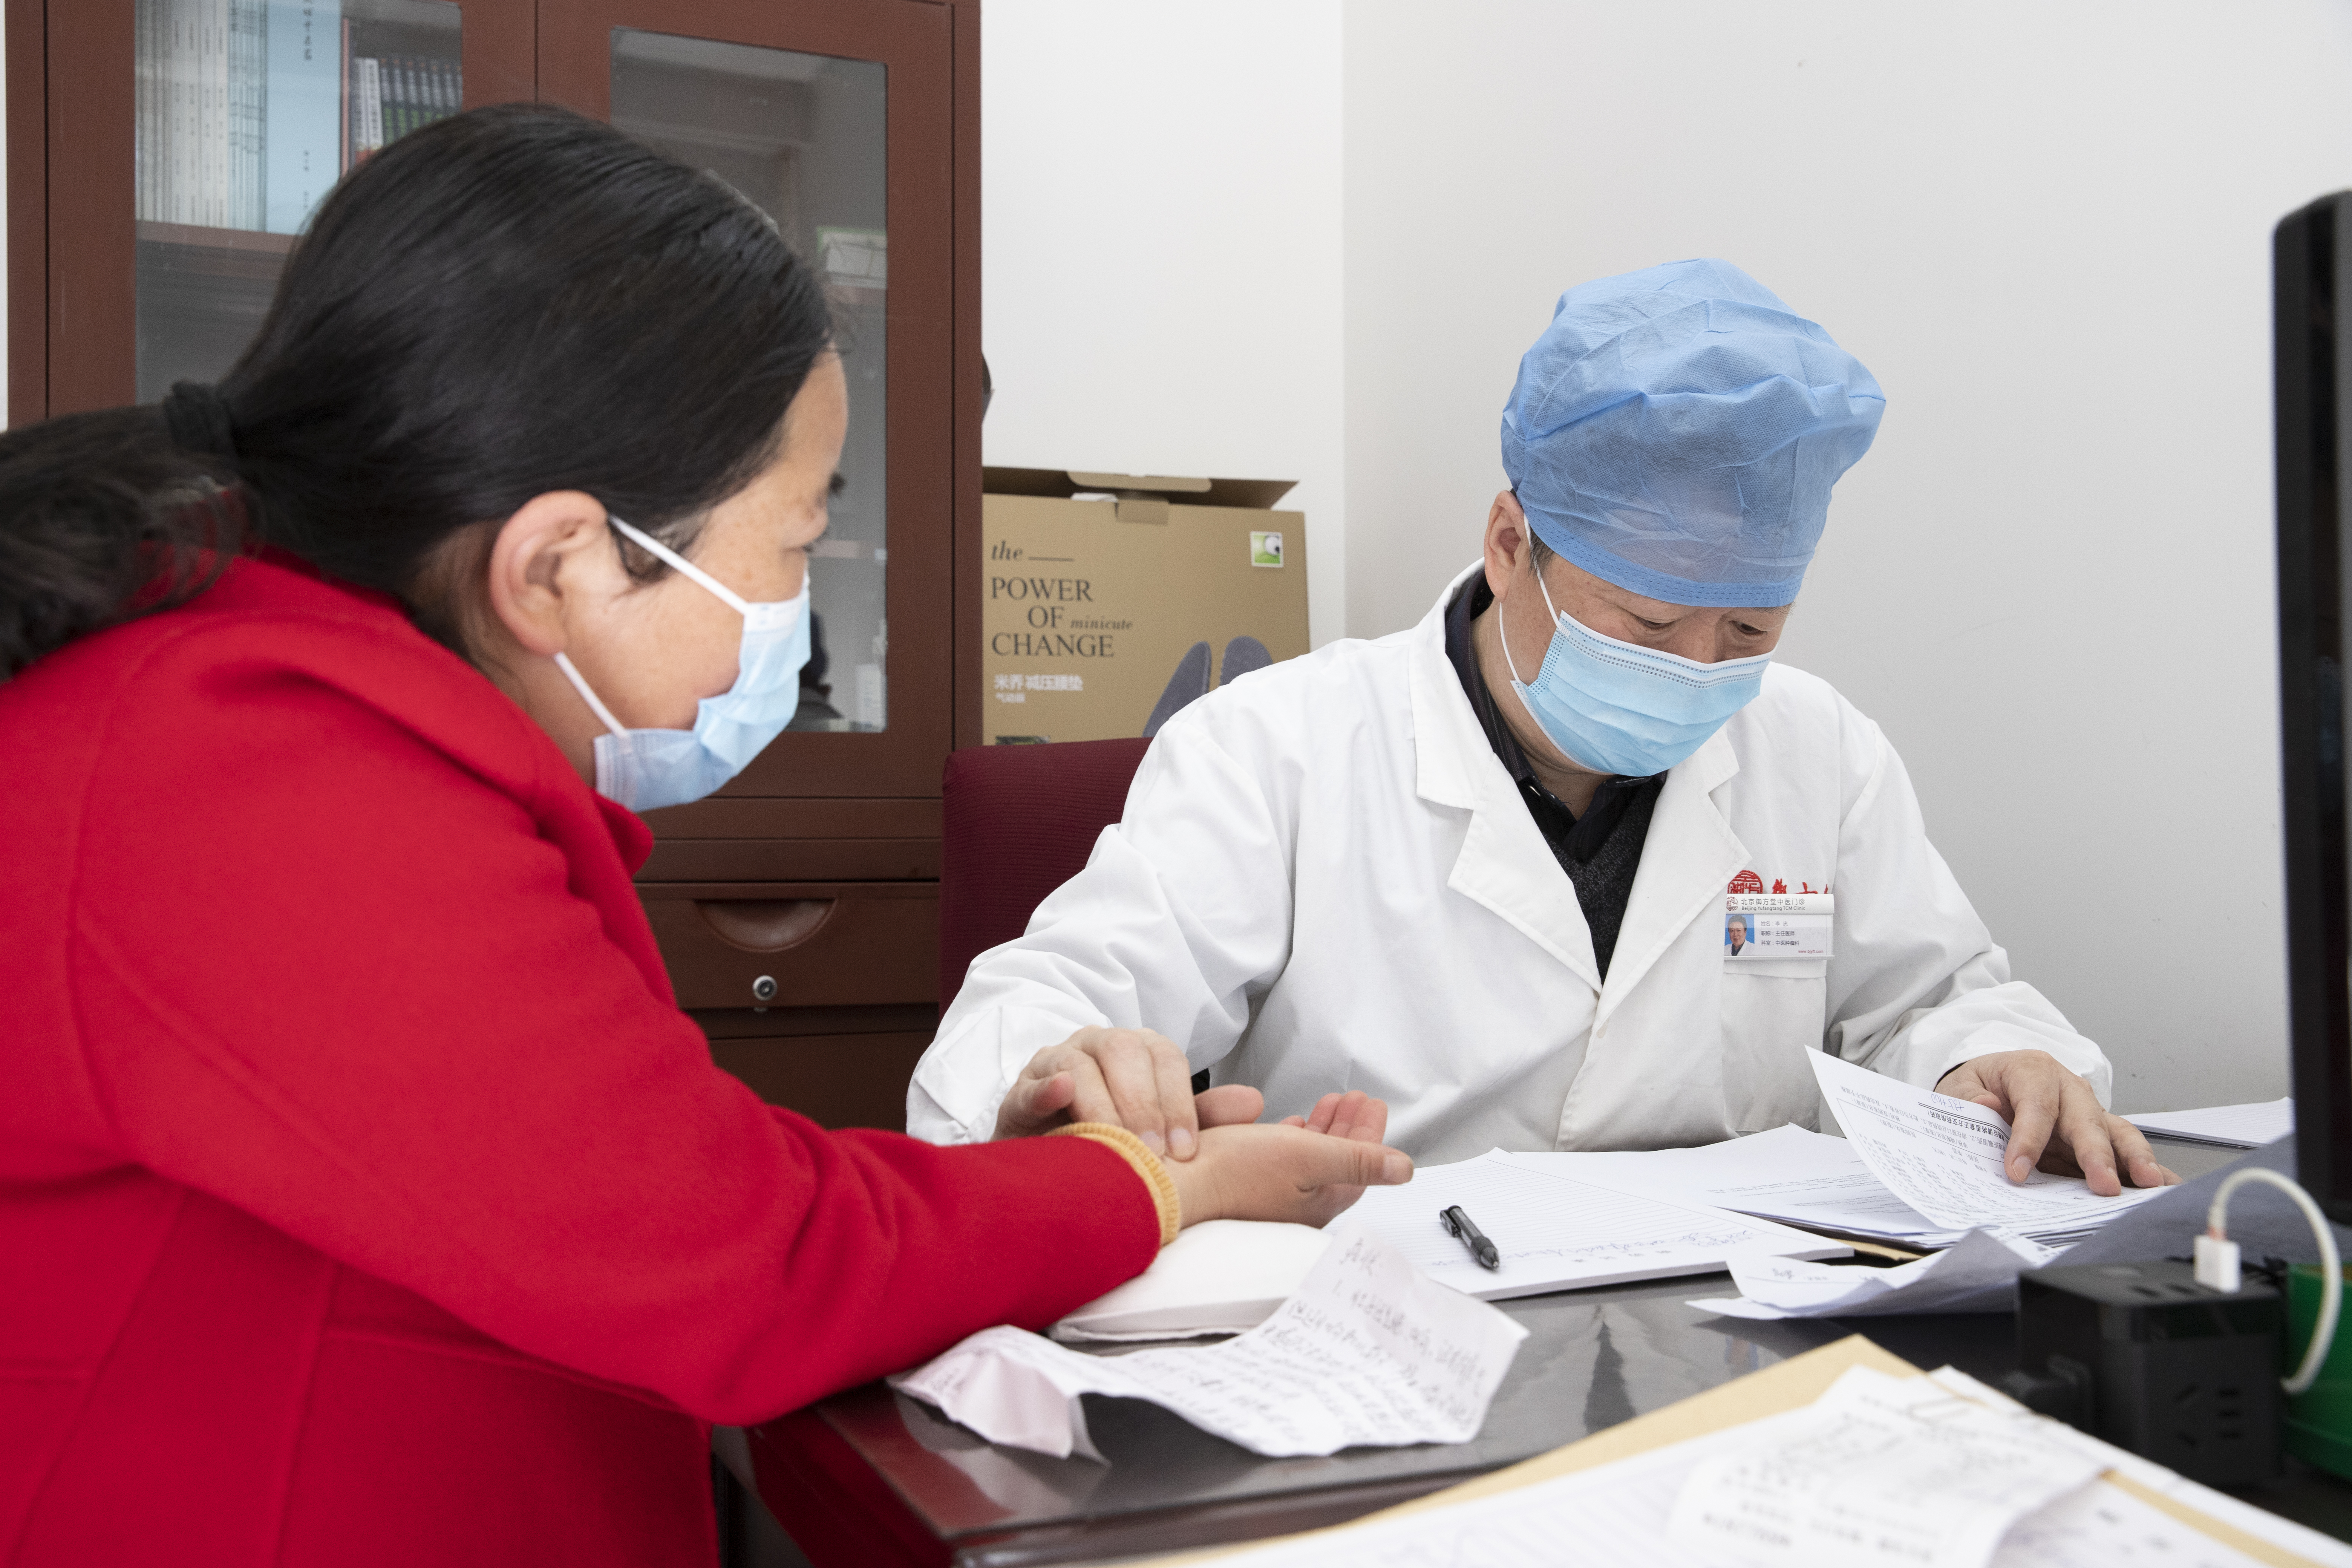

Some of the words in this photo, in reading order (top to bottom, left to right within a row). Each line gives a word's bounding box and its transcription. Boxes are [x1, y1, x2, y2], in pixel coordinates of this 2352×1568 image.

[992, 540, 1023, 560] the
[992, 577, 1093, 602] POWER
[1027, 605, 1064, 629] OF
[1070, 616, 1133, 631] minicute
[992, 632, 1115, 657] CHANGE
